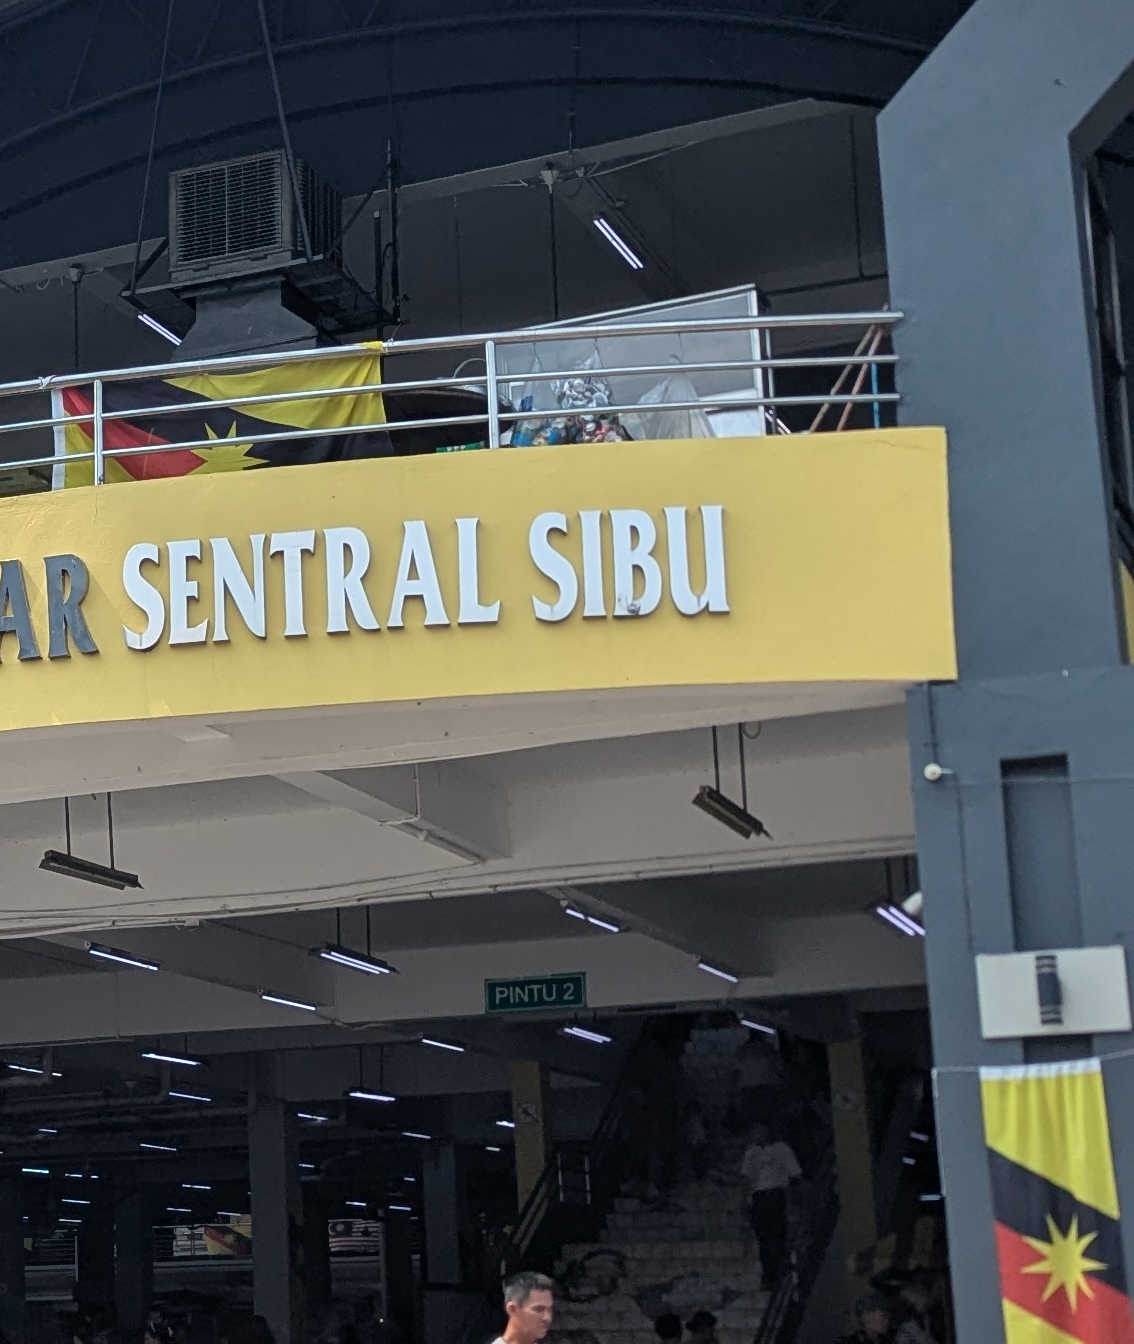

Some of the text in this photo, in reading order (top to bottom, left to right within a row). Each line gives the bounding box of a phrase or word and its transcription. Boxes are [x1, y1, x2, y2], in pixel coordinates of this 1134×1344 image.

[122, 516, 501, 651] SENTRAL
[529, 504, 730, 623] SIBU
[495, 982, 575, 1005] PINTU 2
